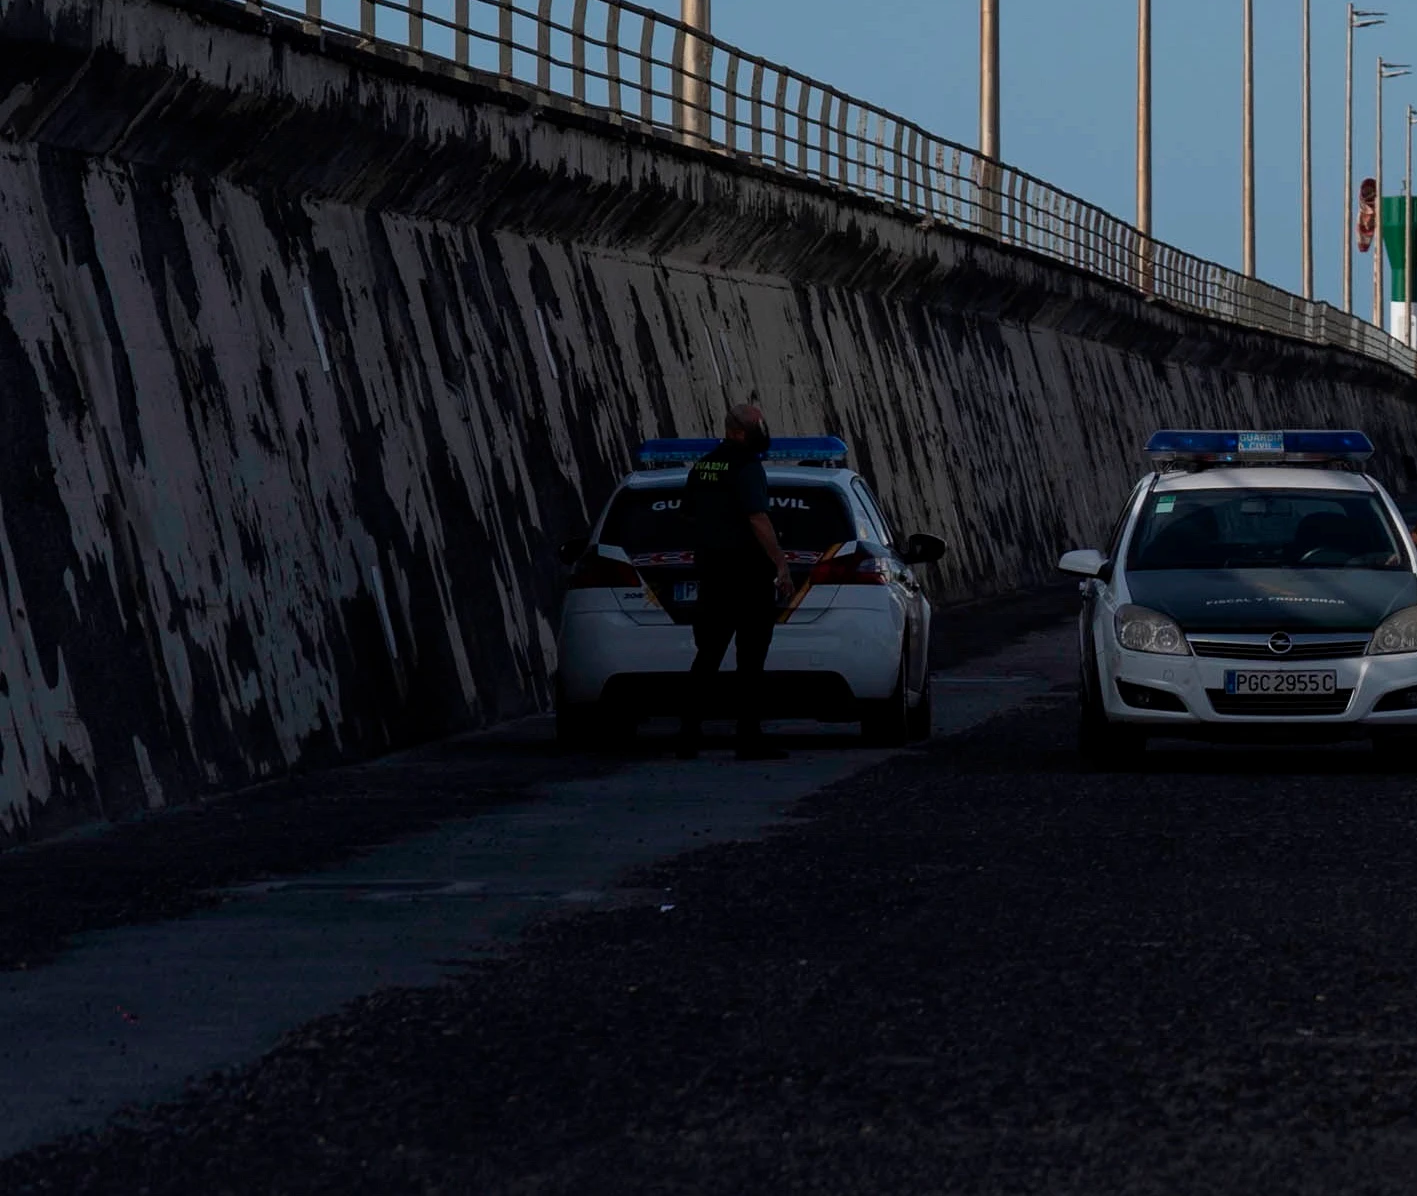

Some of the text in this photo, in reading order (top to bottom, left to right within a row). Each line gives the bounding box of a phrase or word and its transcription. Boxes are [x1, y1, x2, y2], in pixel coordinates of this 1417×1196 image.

[1239, 433, 1283, 442] GUARDIA
[769, 496, 811, 510] IVIL
[1206, 597, 1252, 605] FISCAL
[1236, 674, 1334, 692] PGC 2955 C
